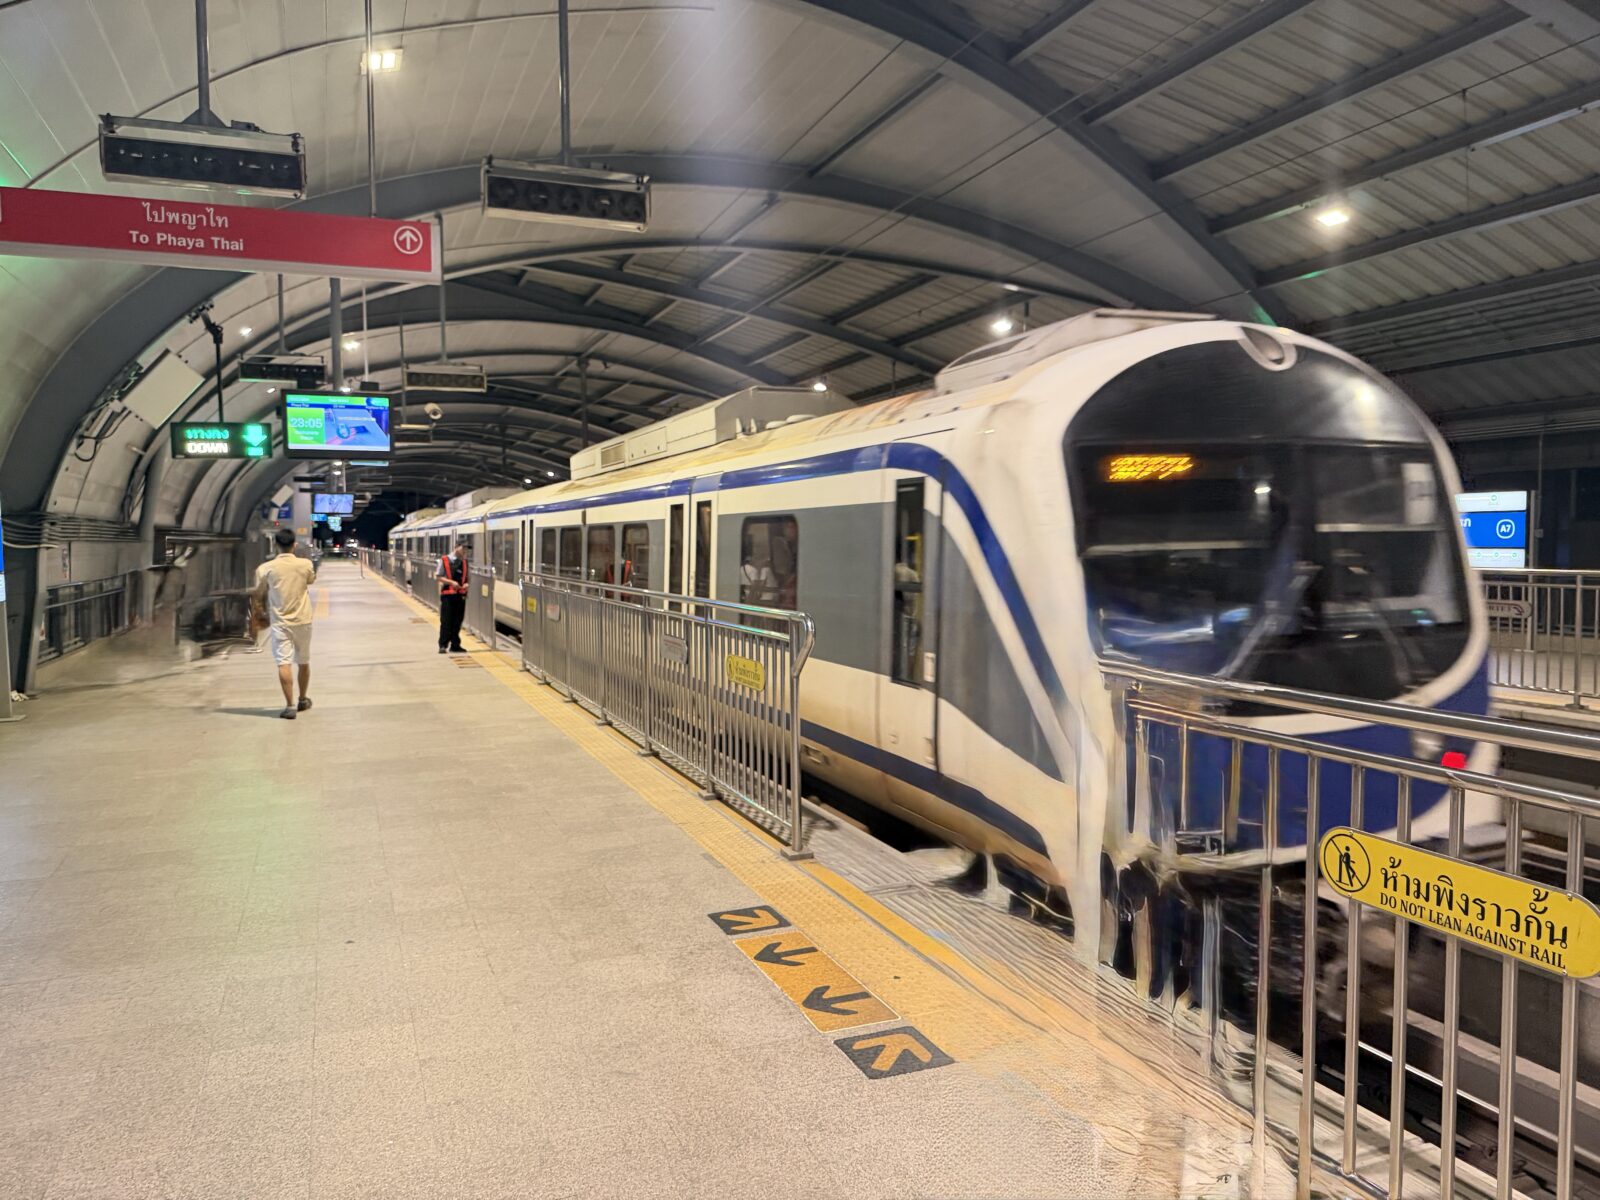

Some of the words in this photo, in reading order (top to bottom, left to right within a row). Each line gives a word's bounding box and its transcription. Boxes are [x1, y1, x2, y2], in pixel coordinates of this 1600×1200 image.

[142, 202, 229, 230] ไปพญาไท
[129, 231, 149, 244] To
[156, 233, 205, 250] Phaya
[211, 237, 244, 251] Thai
[290, 417, 323, 429] 23:05
[187, 442, 229, 454] DOWN
[1500, 525, 1512, 533] A7
[1380, 856, 1568, 949] ห้ามพิงราวกั้น
[1380, 892, 1397, 909] DO
[1400, 899, 1425, 919] NOT
[1429, 909, 1462, 932] LEAN
[1465, 922, 1526, 954] AGAINST
[1530, 944, 1566, 970] RAIL
